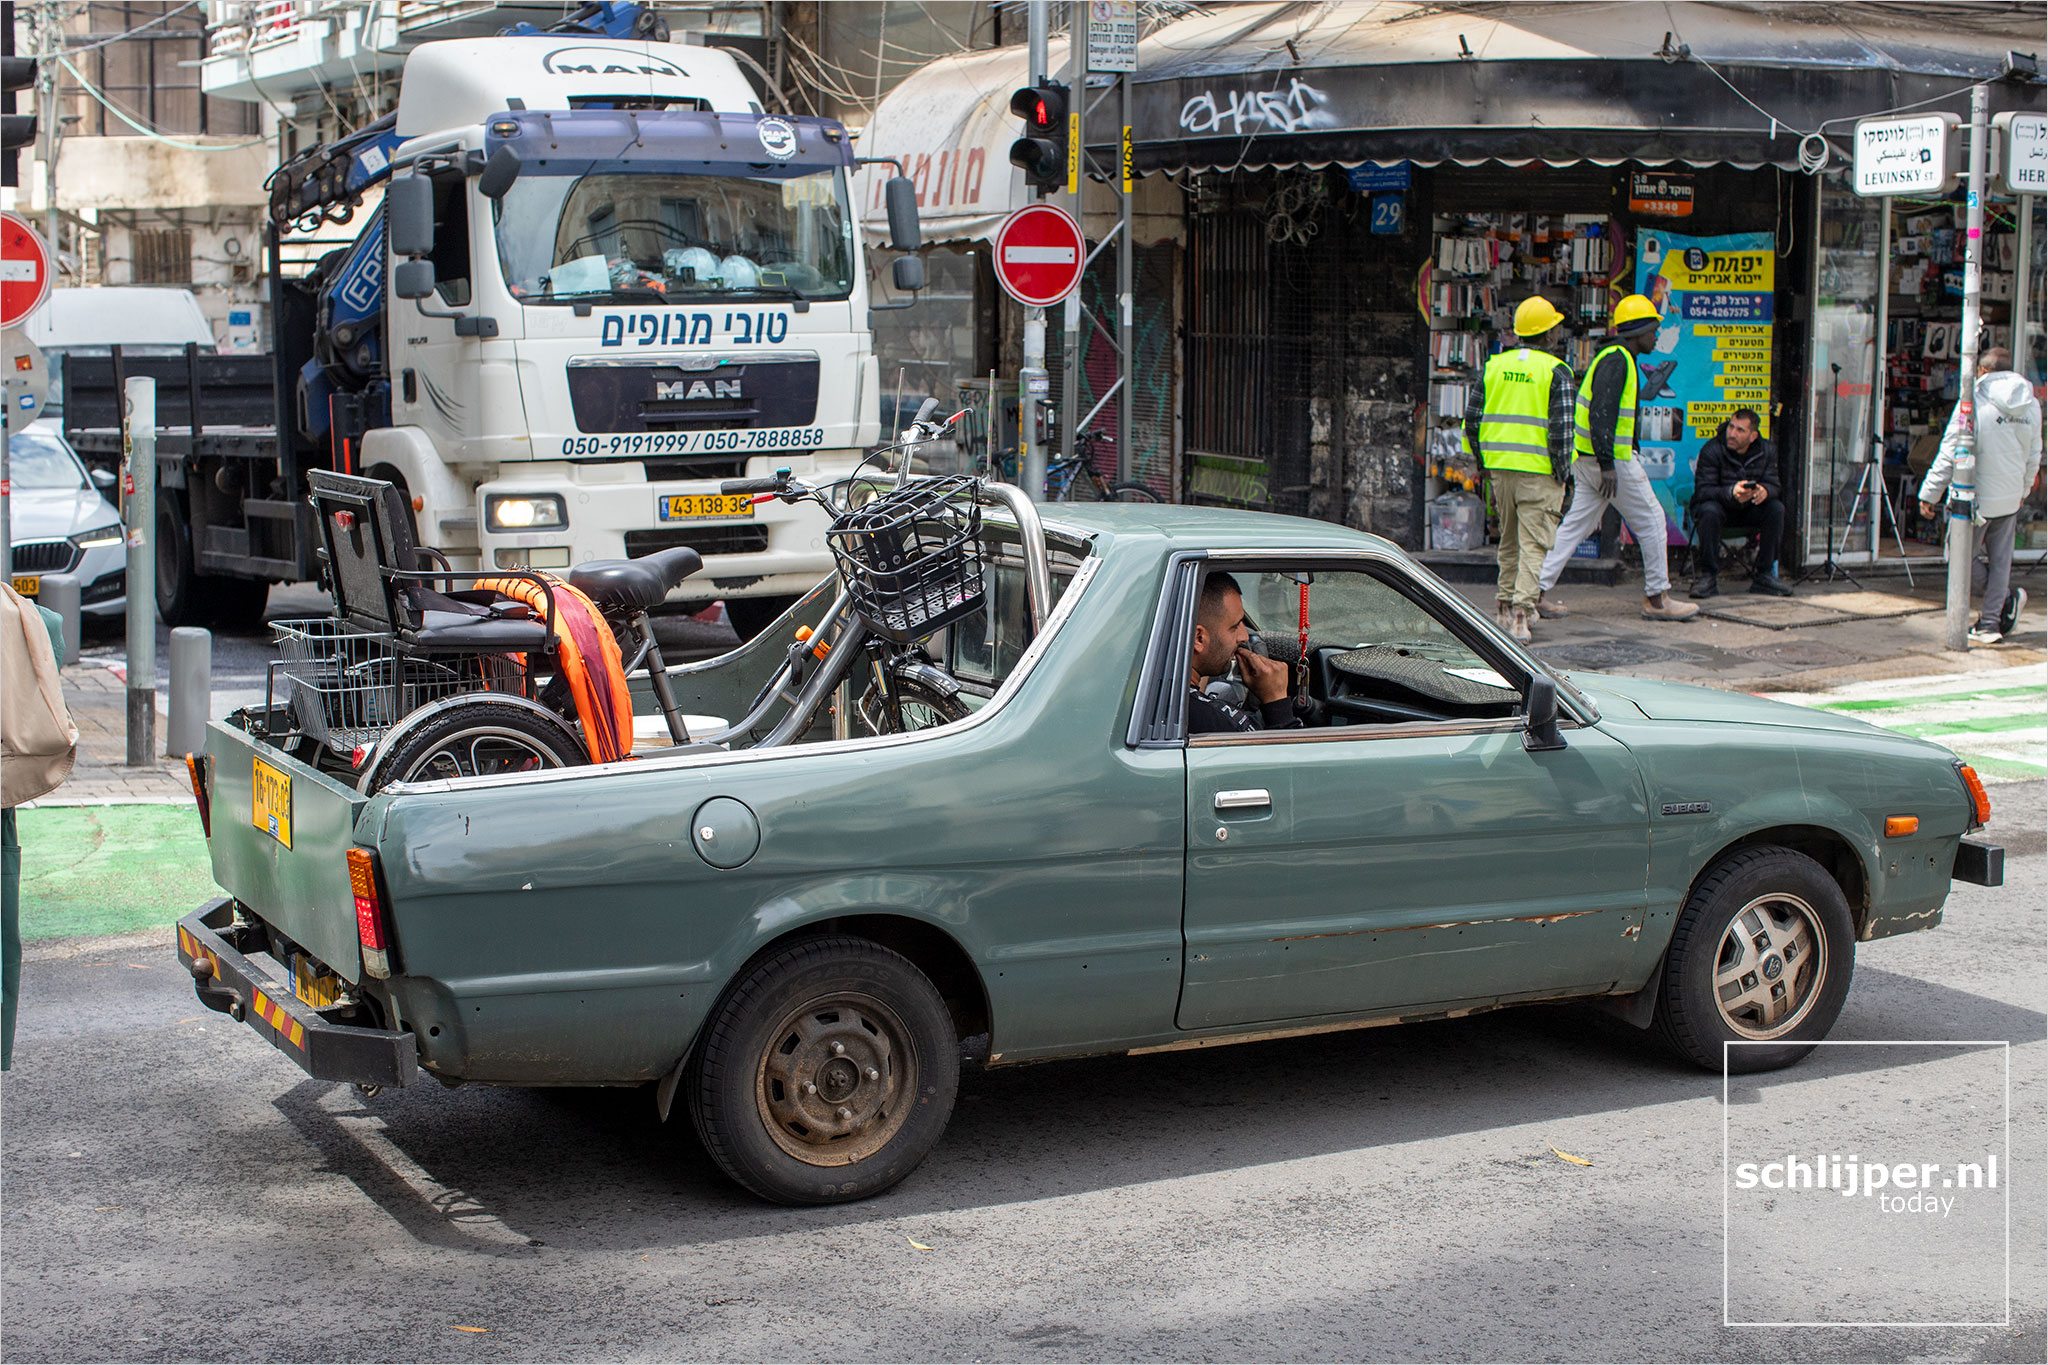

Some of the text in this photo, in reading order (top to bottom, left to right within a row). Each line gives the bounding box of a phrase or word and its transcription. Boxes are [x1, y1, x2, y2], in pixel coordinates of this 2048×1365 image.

[556, 65, 678, 76] MAN
[1863, 125, 1905, 146] לוינסקי
[1123, 127, 1132, 181] 463
[1865, 169, 1921, 185] LEVINSKY
[1634, 184, 1692, 196] מוקד אמון
[1375, 202, 1400, 227] 29
[1713, 256, 1763, 273] יפתח
[1688, 273, 1762, 285] ייבוא אביזרים
[1728, 295, 1750, 306] הרצל
[1689, 307, 1750, 318] 054-4267575
[601, 313, 713, 347] מנופים
[724, 312, 788, 345] טובי
[1735, 325, 1764, 334] אביזרי
[1729, 338, 1764, 347] מטענים
[1723, 351, 1764, 360] מכשירים
[1730, 364, 1763, 373] אוזניות
[1724, 376, 1763, 387] רמקולים
[656, 379, 742, 401] MAN
[1735, 390, 1763, 399] מגנים
[1693, 403, 1727, 414] תיקונים
[562, 433, 689, 456] 050-9191999
[703, 428, 824, 451] 050-7888858
[1661, 801, 1710, 815] SUBARU
